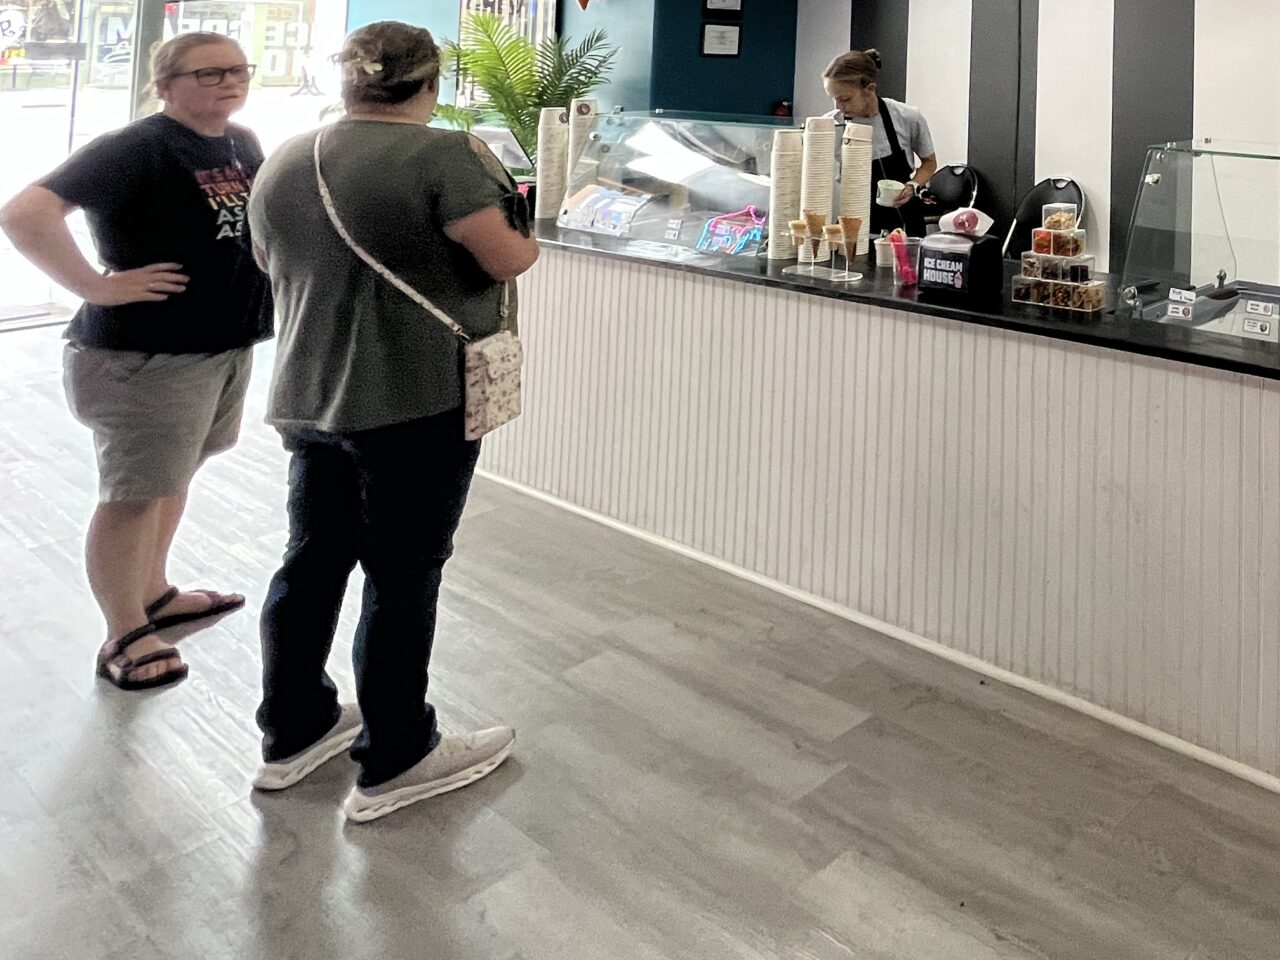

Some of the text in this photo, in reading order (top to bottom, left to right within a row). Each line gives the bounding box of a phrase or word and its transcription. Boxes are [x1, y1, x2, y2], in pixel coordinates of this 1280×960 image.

[924, 257, 963, 272] ICE CREAM
[923, 268, 954, 285] HOUSE
